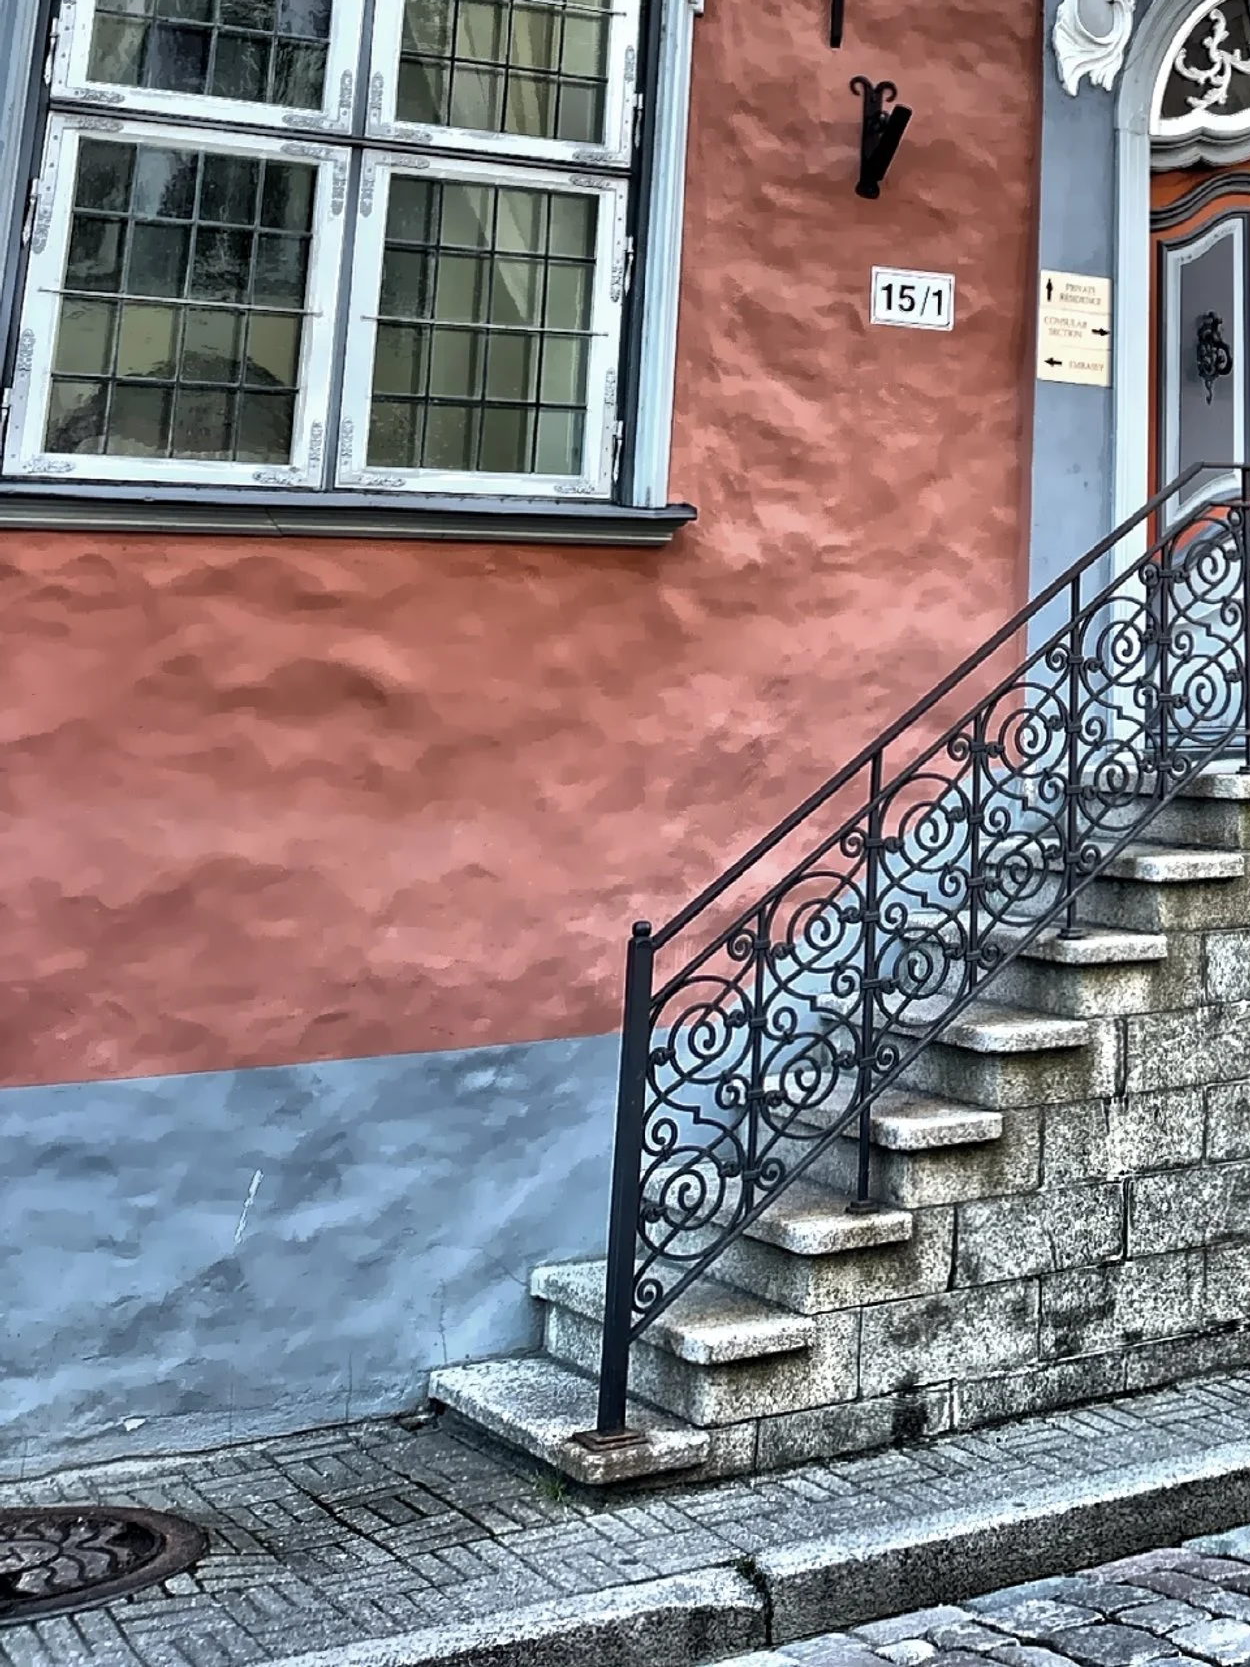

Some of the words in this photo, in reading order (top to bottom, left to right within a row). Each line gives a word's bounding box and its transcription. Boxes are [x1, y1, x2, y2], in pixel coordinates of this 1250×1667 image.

[881, 282, 944, 317] 15/1
[1043, 316, 1087, 329] CONSULAR
[1047, 327, 1083, 339] SECTION
[1068, 360, 1105, 372] EMBASSY
